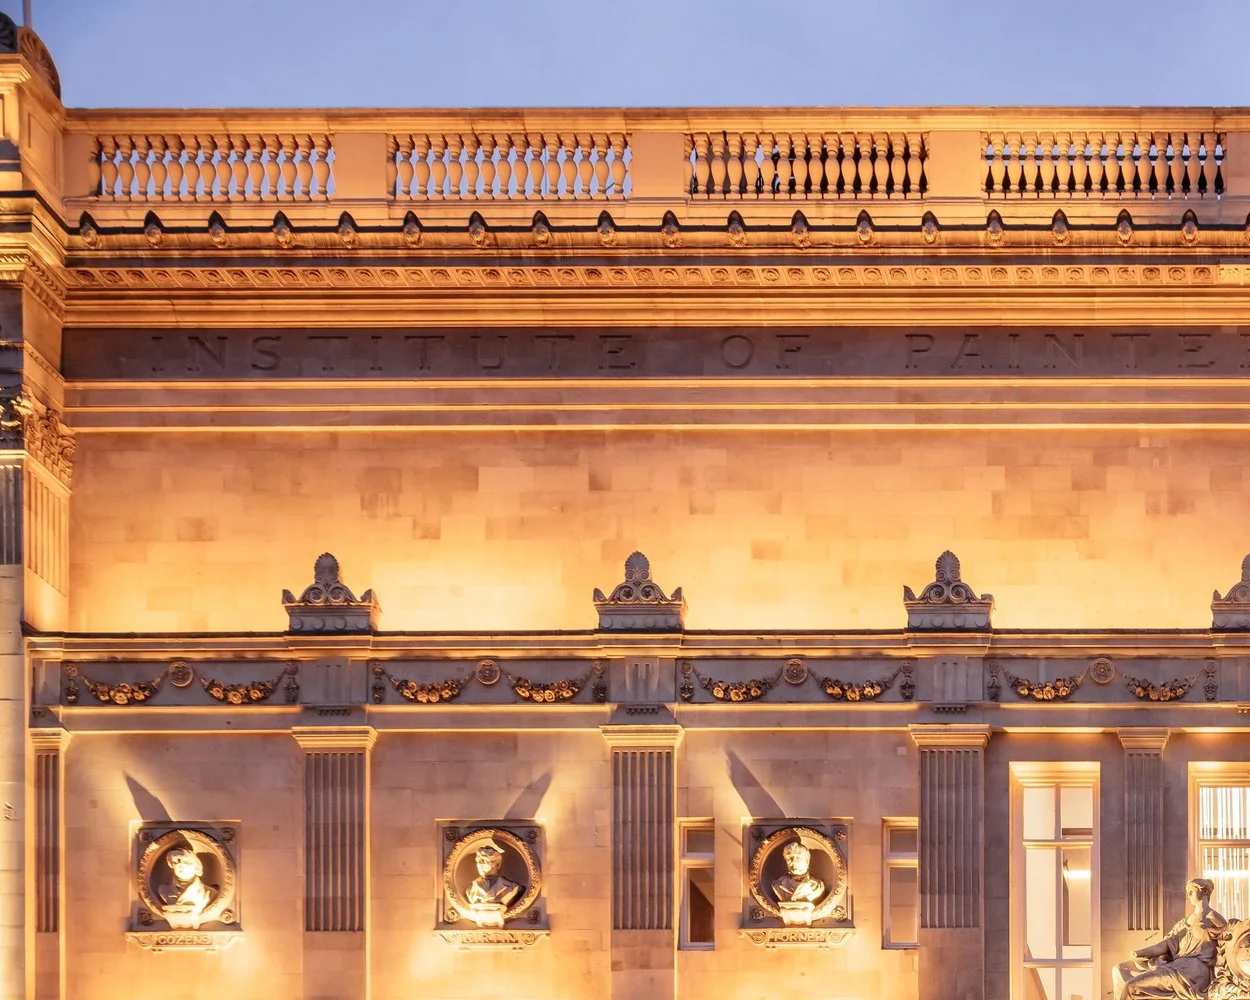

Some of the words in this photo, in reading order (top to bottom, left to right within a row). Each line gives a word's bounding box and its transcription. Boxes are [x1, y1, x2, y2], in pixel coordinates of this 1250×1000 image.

[150, 334, 638, 372] INSTITUTE
[719, 334, 811, 371] OF
[771, 931, 825, 942] TURNER
